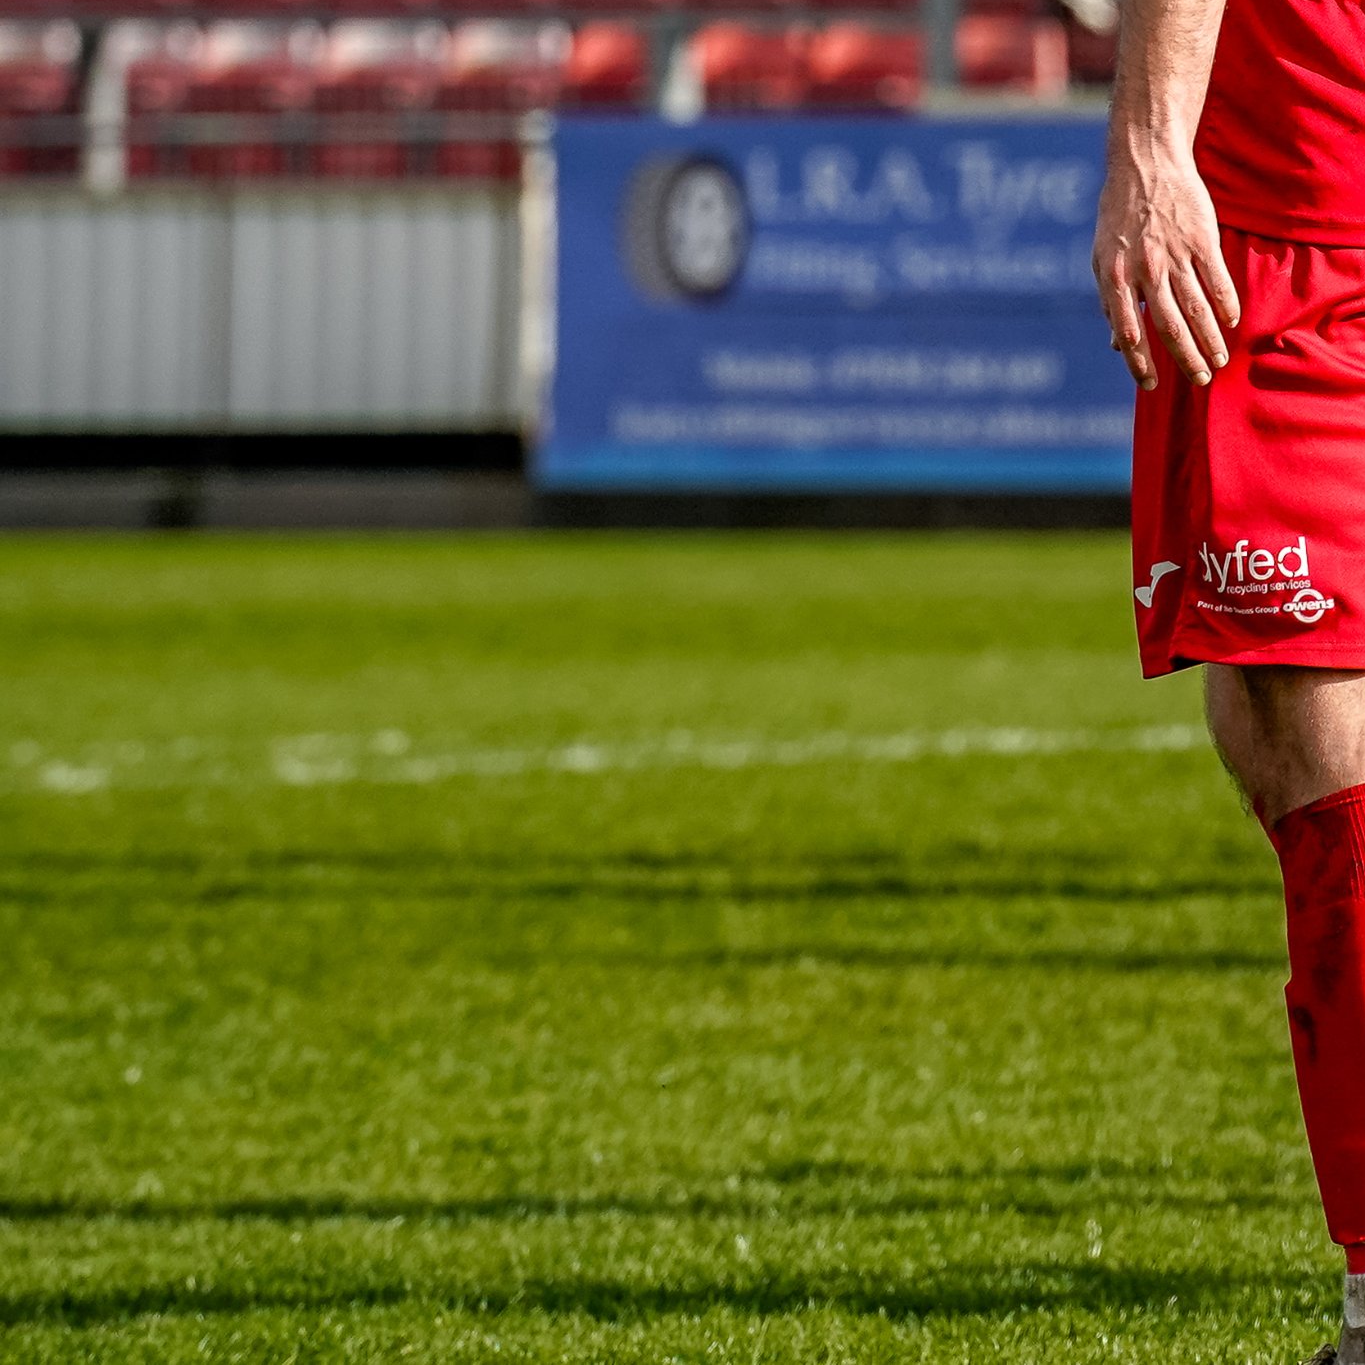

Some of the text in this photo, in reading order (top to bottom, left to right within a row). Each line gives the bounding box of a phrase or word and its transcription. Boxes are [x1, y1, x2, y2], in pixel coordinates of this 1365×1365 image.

[1226, 579, 1312, 596] recycling services
[1254, 606, 1280, 615] Group
[1283, 598, 1335, 613] owens
